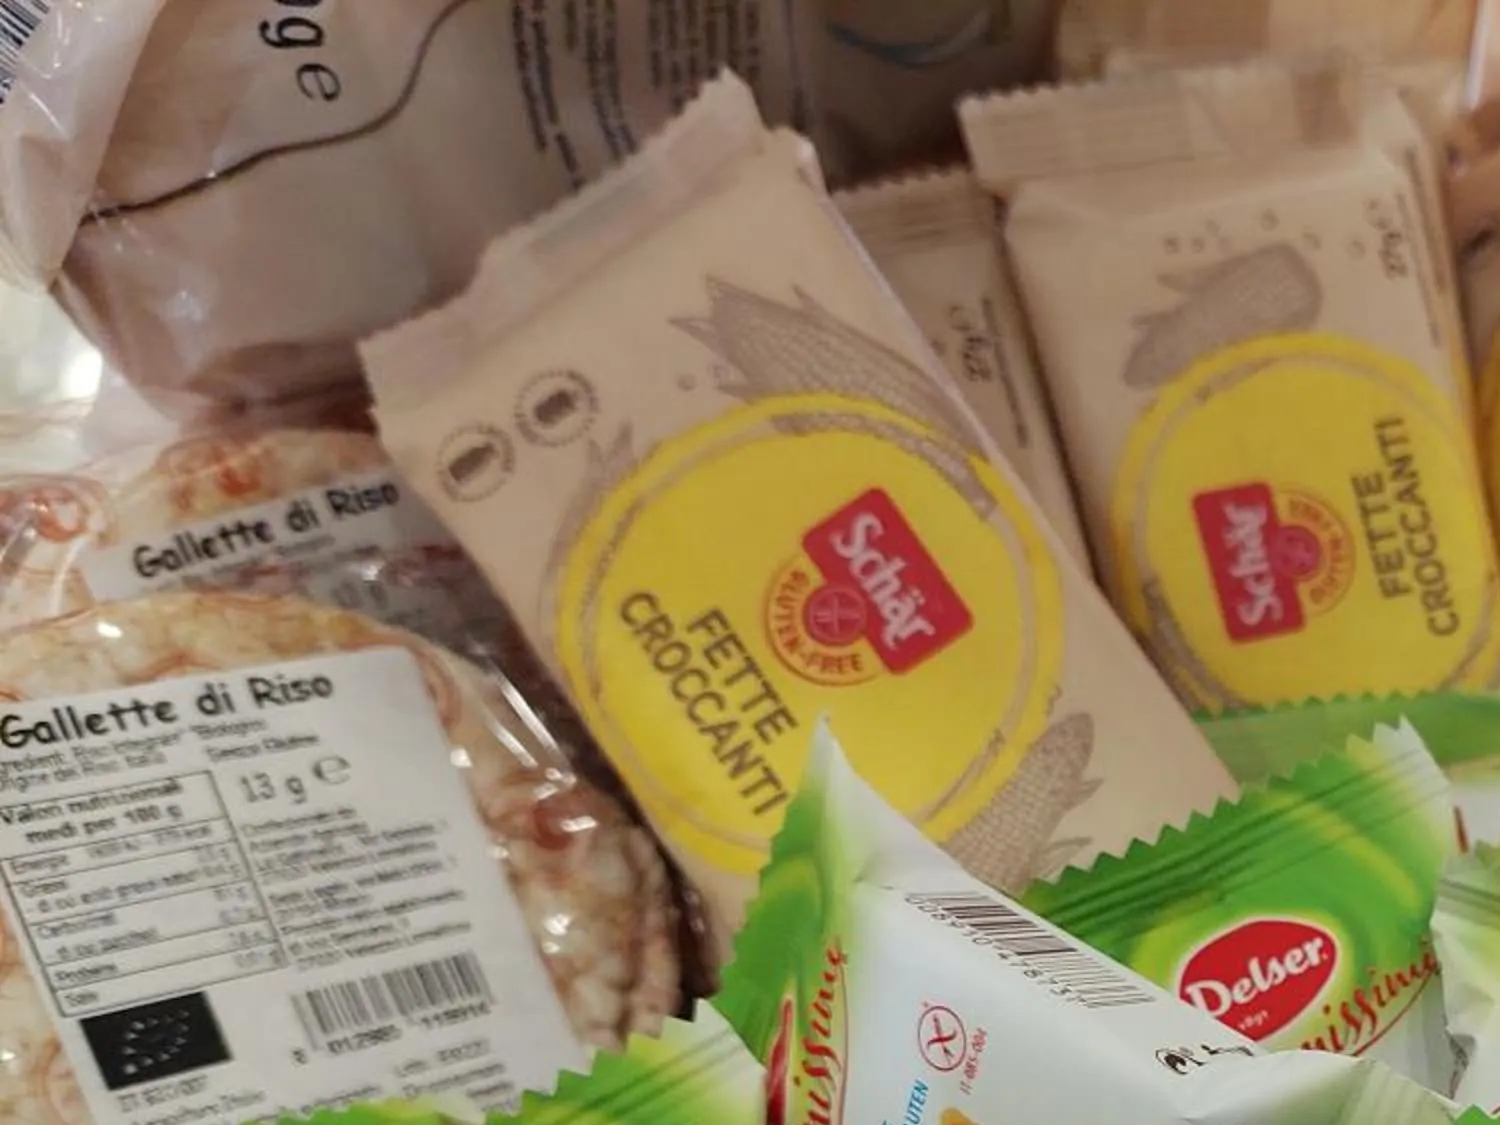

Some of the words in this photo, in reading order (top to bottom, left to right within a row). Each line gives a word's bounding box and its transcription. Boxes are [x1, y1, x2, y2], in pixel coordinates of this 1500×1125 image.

[132, 519, 276, 579] Gallette
[285, 499, 321, 534] di
[829, 511, 937, 649] Schär
[1221, 501, 1284, 627] Schär
[1352, 472, 1413, 599] FETTE
[1373, 418, 1460, 637] CROCCANTI
[0, 699, 179, 749] Gallette
[195, 682, 236, 716] di
[247, 673, 335, 708] Riso
[618, 590, 787, 818] CROCCANTI
[686, 608, 798, 745] FETTE
[239, 771, 277, 804] 13
[1184, 935, 1325, 1018] Delser
